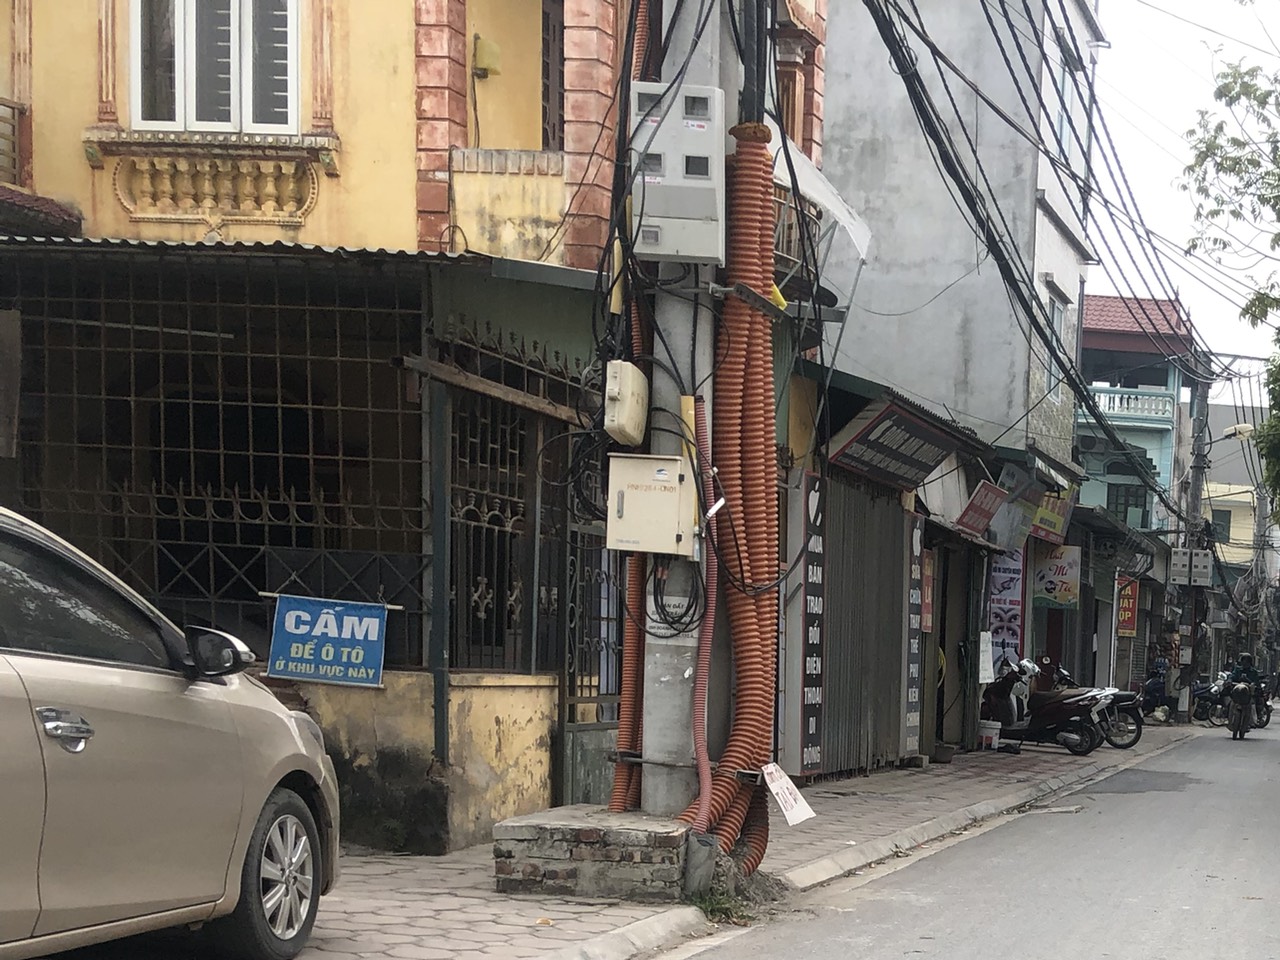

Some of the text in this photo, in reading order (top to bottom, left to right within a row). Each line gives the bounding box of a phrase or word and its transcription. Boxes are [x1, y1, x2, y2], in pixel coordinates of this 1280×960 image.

[808, 562, 822, 584] BÁN
[806, 595, 823, 615] TRAO
[284, 606, 380, 641] CẤM
[290, 639, 365, 664] ĐỂ Ô TÔ
[275, 656, 376, 679] Ở KHU VỰC NÀY
[806, 653, 821, 678] ĐIỆN
[804, 686, 822, 708] THOẠI
